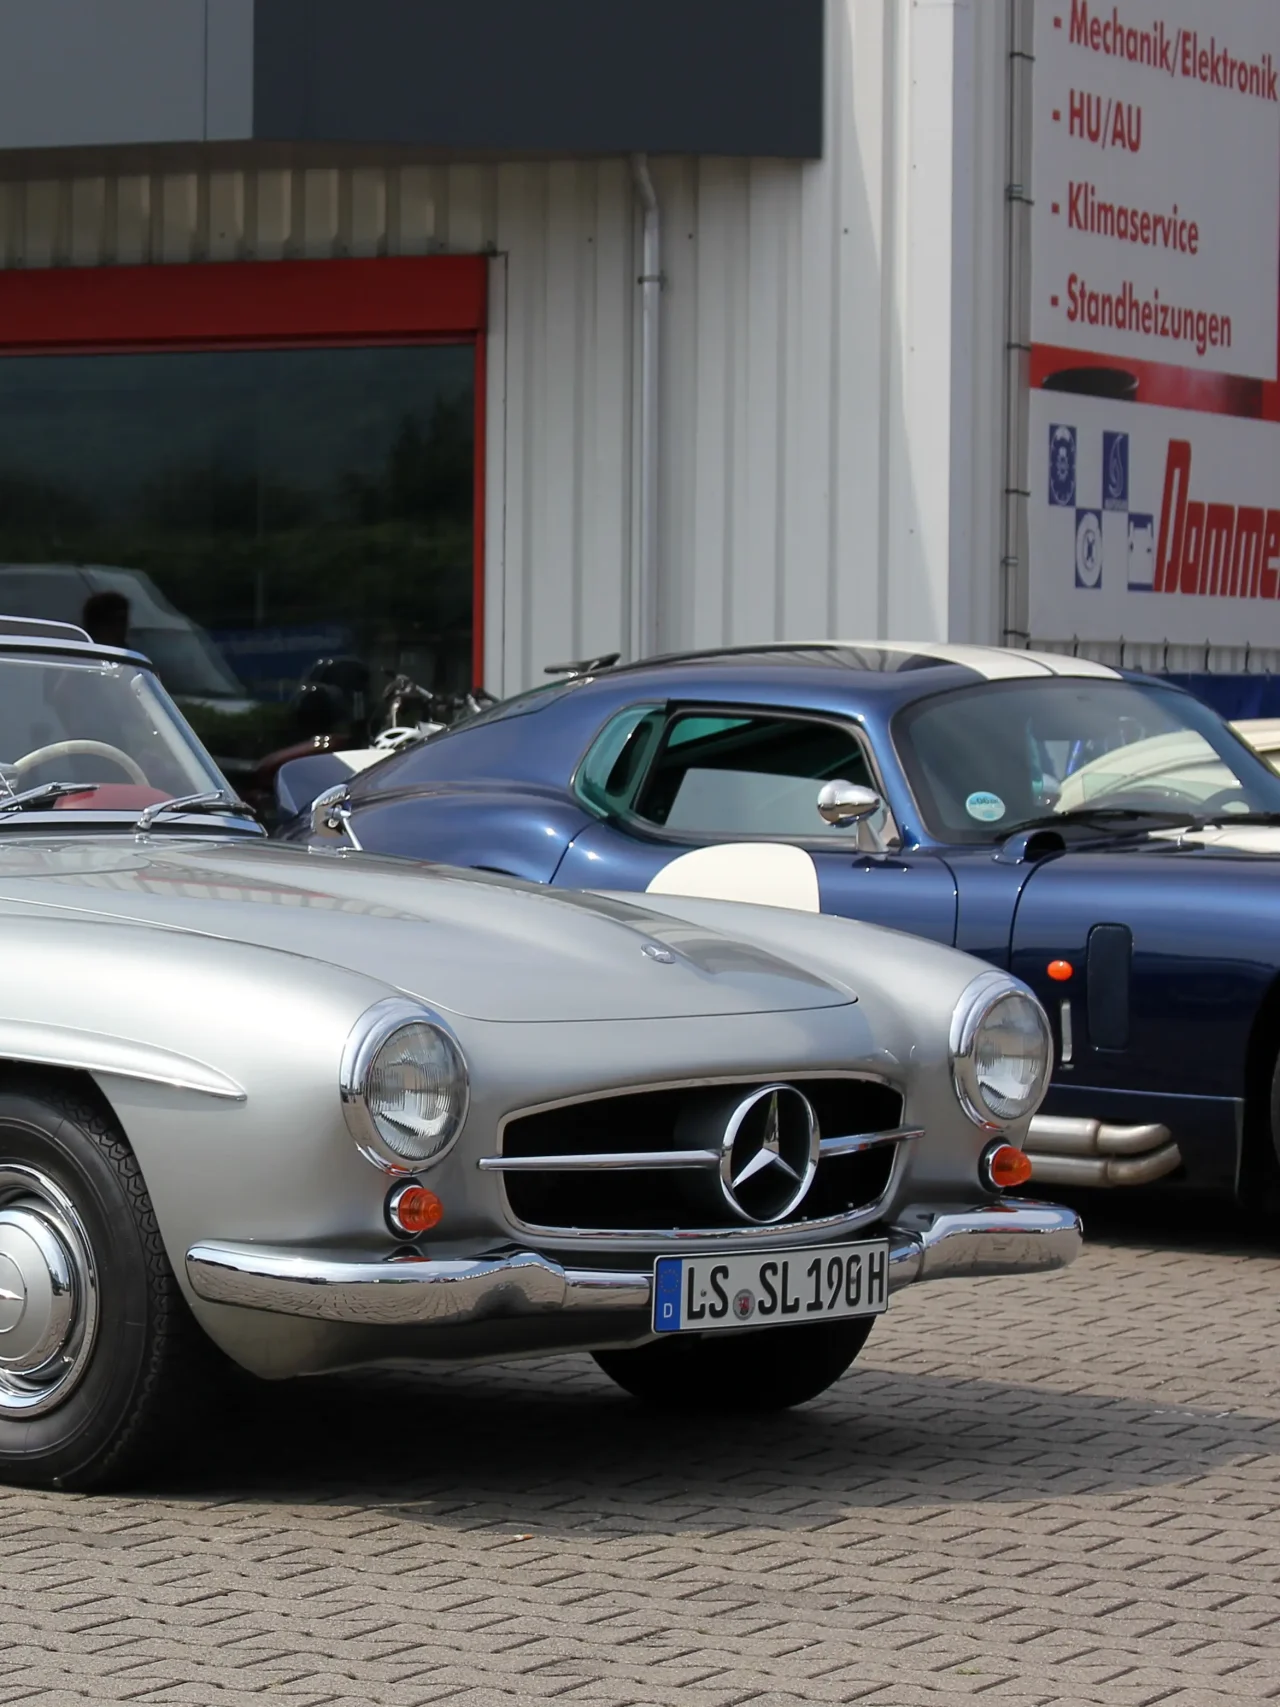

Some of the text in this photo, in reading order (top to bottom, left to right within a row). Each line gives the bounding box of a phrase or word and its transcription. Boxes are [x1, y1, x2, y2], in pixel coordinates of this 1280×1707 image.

[1069, 0, 1278, 101] Mechanik/Elektronik
[1068, 88, 1142, 152] HU/AU
[1068, 181, 1199, 255] Klimaservice
[1067, 273, 1231, 355] Standheizungen
[686, 1265, 729, 1320] LS
